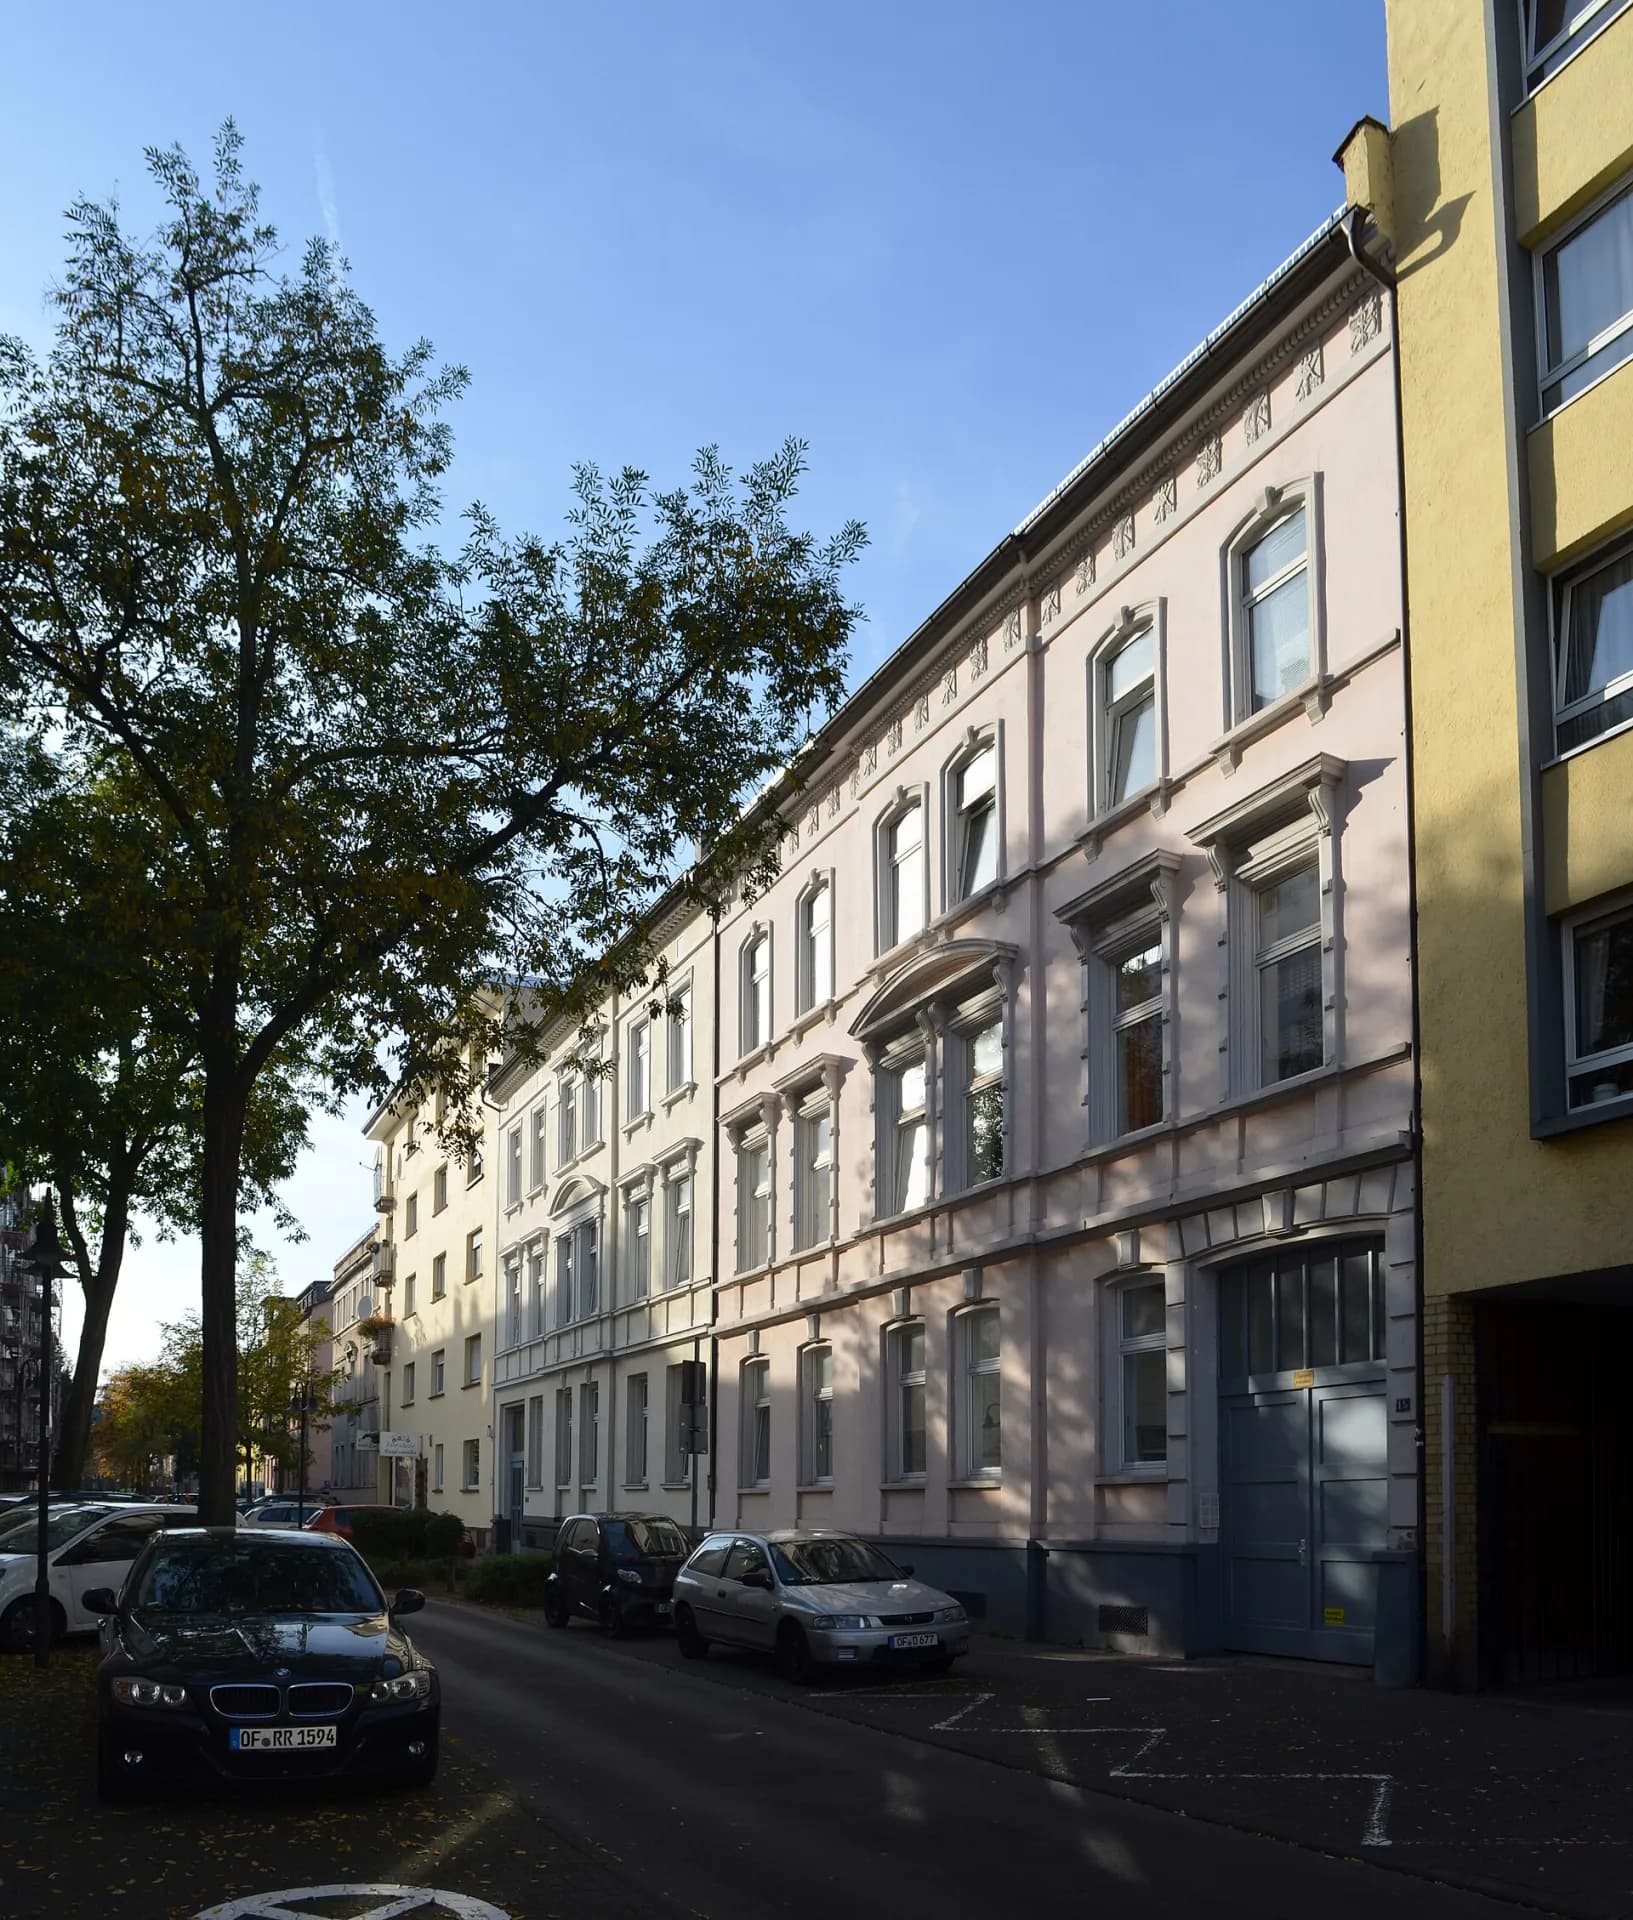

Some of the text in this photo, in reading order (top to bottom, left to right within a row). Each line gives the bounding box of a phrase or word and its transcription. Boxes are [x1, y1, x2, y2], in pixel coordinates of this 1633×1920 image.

[897, 1636, 908, 1647] OF
[919, 1634, 934, 1645] 677
[241, 1728, 335, 1747] OF RR 1594
